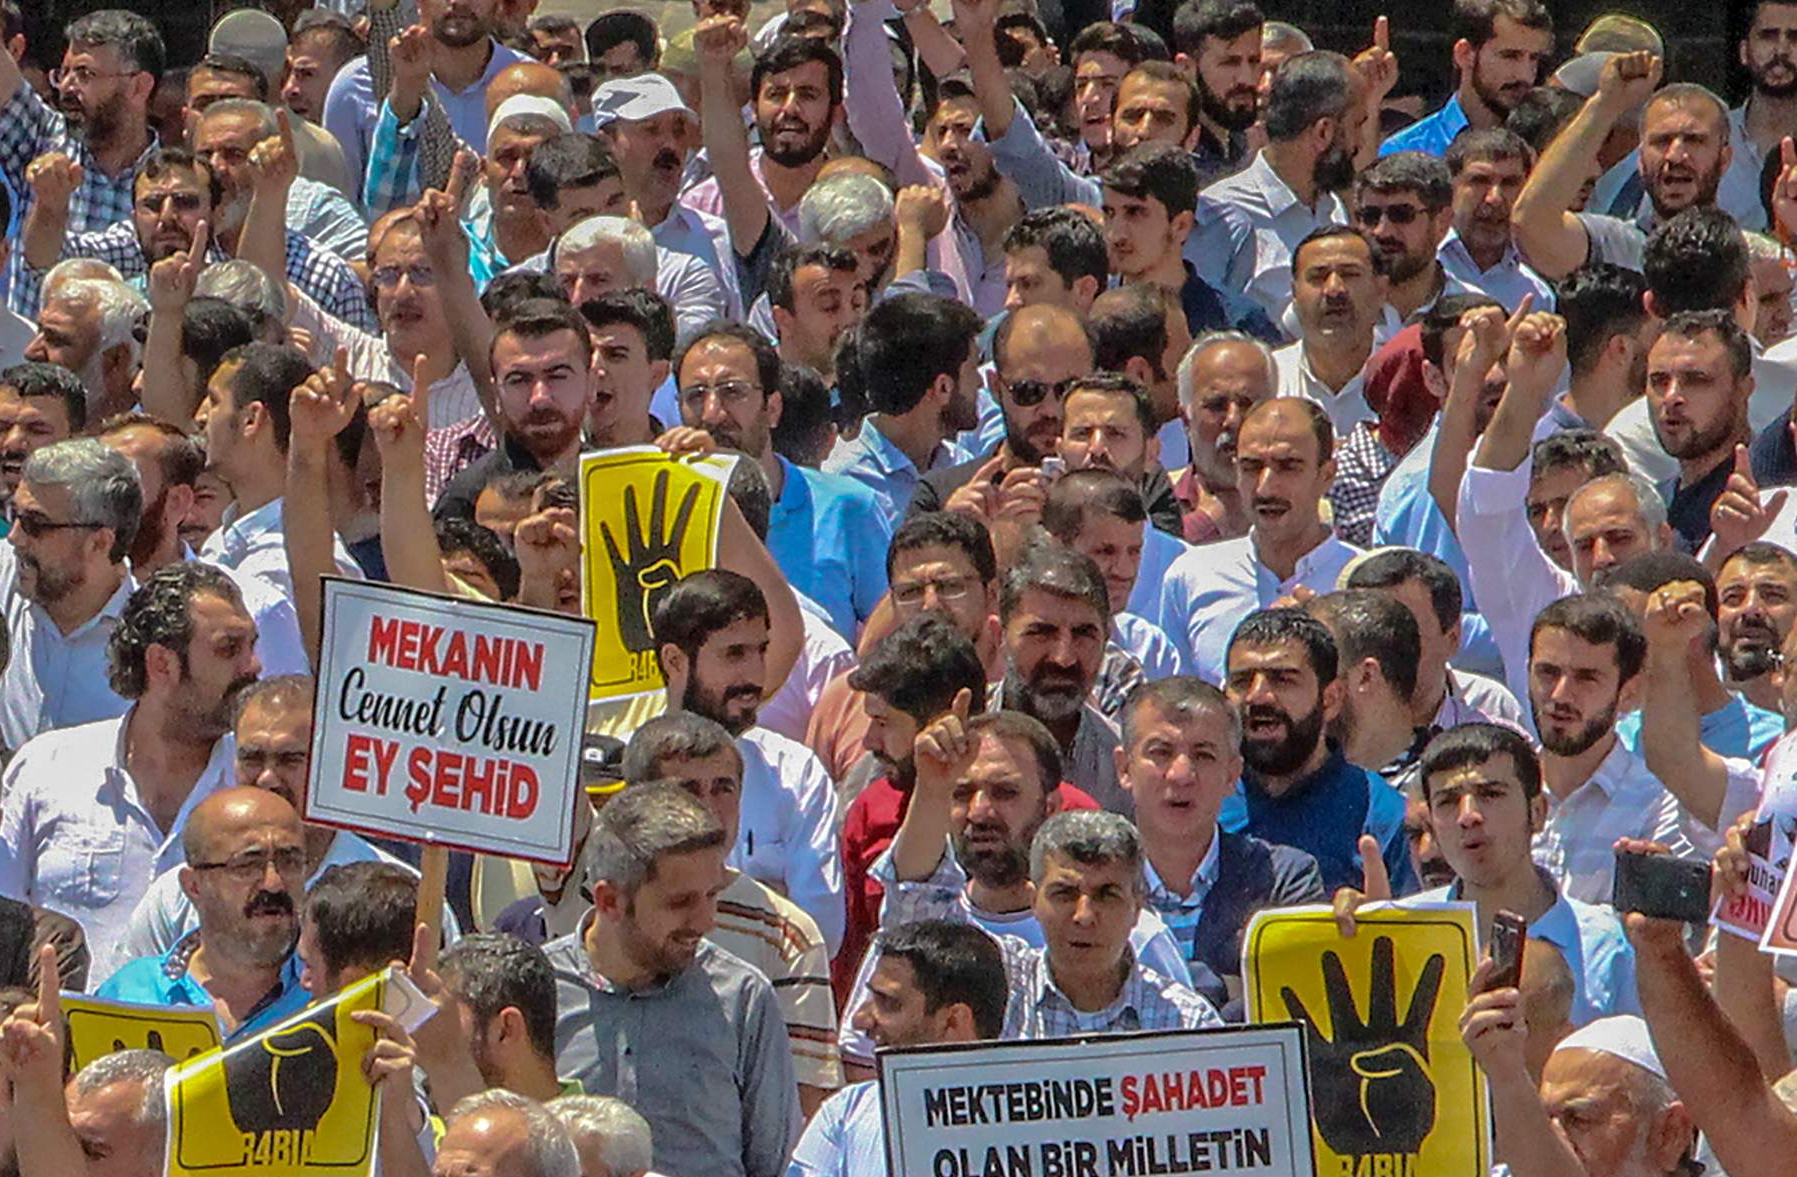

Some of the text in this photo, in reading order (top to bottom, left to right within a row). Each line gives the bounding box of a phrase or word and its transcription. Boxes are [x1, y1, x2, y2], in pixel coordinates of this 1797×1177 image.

[367, 615, 545, 692] MEKANIN
[339, 667, 559, 757] Cennet Olsun
[342, 733, 540, 820] EY ŞEHİD
[924, 1066, 1267, 1128] MEKTEBİNDE ŞAHADET
